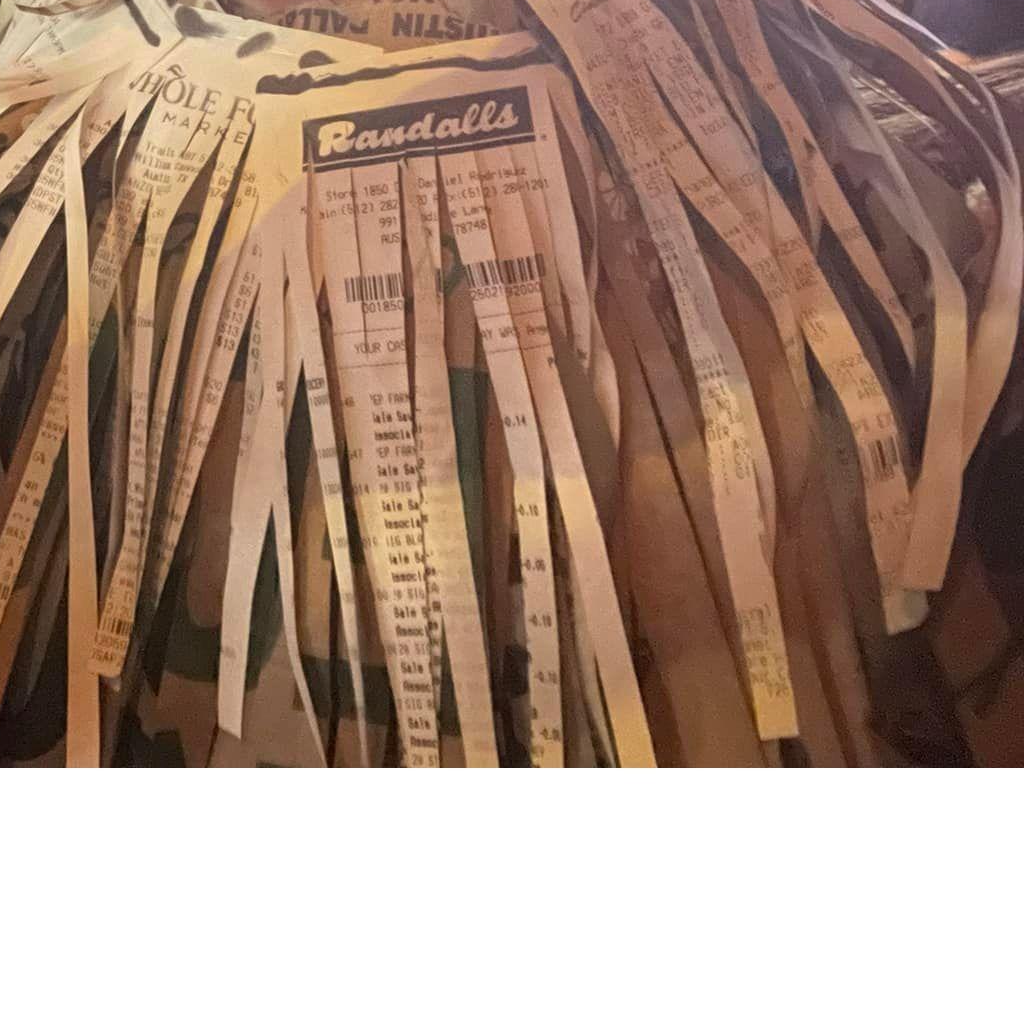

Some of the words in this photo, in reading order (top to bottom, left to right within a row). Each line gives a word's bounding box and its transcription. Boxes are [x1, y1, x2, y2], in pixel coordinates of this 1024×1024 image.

[392, 11, 500, 40] USTIN
[319, 100, 520, 157] Randalls
[363, 183, 389, 197] 1850
[354, 342, 381, 354] YOUR
